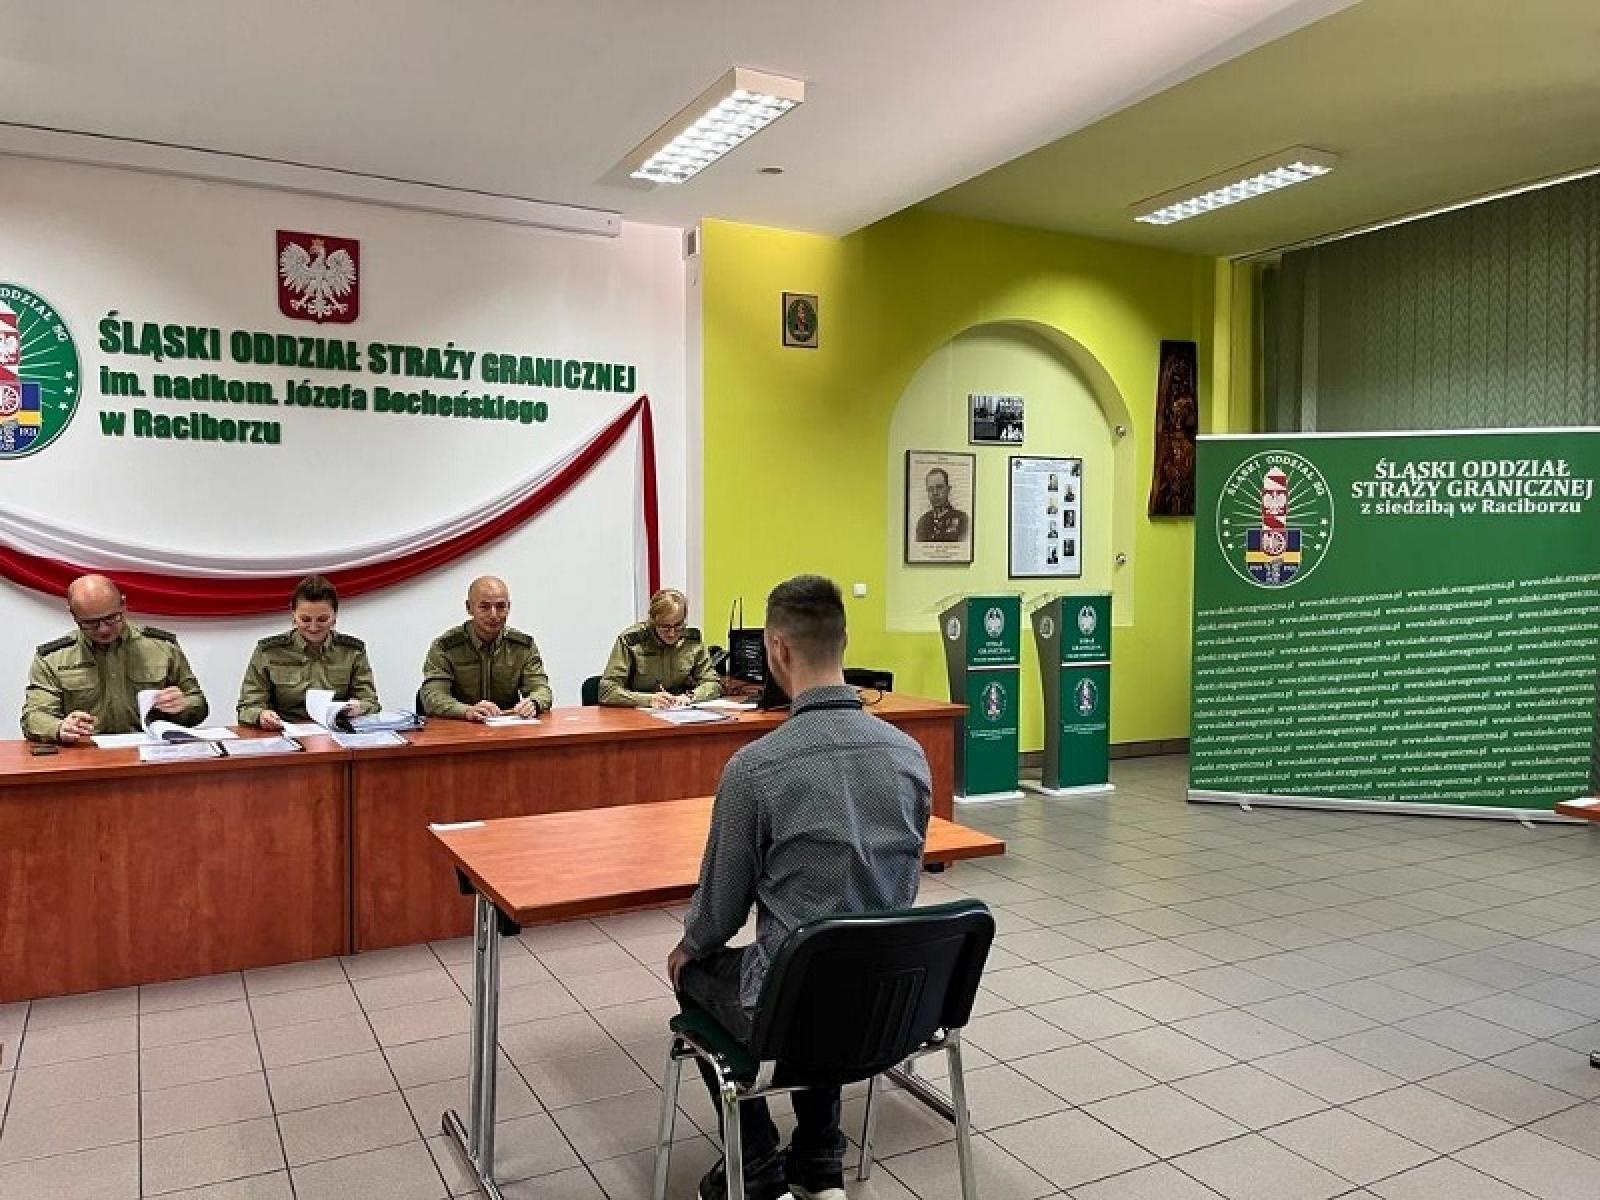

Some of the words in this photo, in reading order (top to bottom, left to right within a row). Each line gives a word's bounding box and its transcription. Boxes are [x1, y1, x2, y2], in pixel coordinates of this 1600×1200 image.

[98, 310, 221, 362] ŚLĄSKI
[230, 329, 362, 372] ODDZIAŁ
[368, 342, 476, 381] STRAŻY
[481, 352, 637, 394] GRANICZNEJ
[99, 365, 146, 396] im.
[153, 373, 278, 405] nadkom.
[283, 379, 368, 410] Józefa
[373, 386, 549, 425] Bocheńskiego
[98, 411, 126, 436] w
[133, 408, 281, 444] Raciborzu
[1375, 457, 1456, 482] ŚLĄSKI
[1462, 459, 1571, 478] ODDZIAŁ
[1351, 477, 1441, 499] STRAŻY
[1447, 479, 1594, 500] GRANICZNEJ
[1360, 502, 1371, 514] z
[1375, 500, 1455, 518] siedzibą
[1459, 502, 1477, 513] w
[1481, 498, 1582, 513] Raciborzu
